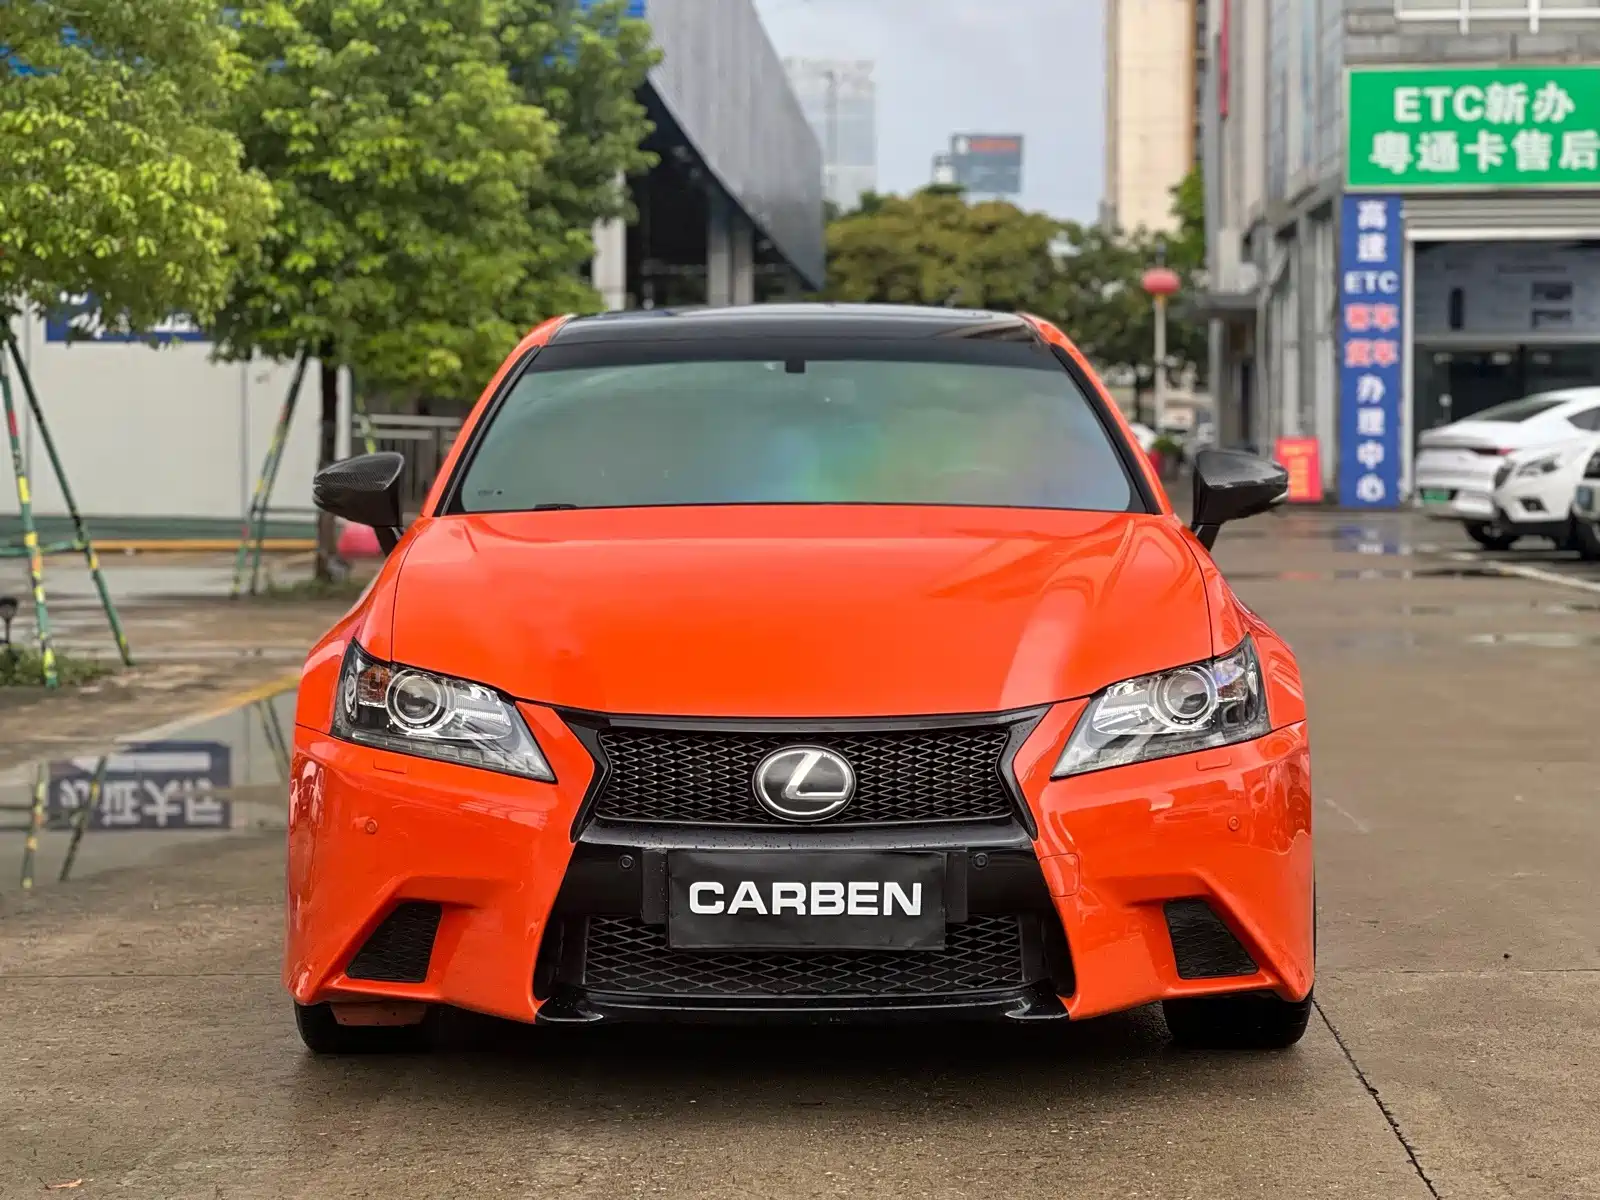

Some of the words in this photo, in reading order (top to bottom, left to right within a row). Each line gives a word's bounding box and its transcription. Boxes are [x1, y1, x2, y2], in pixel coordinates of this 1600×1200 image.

[1393, 82, 1575, 125] ETC新办
[1368, 129, 1600, 174] 粤通卡售后
[1344, 270, 1400, 295] ETC
[688, 880, 923, 917] CARBEN
